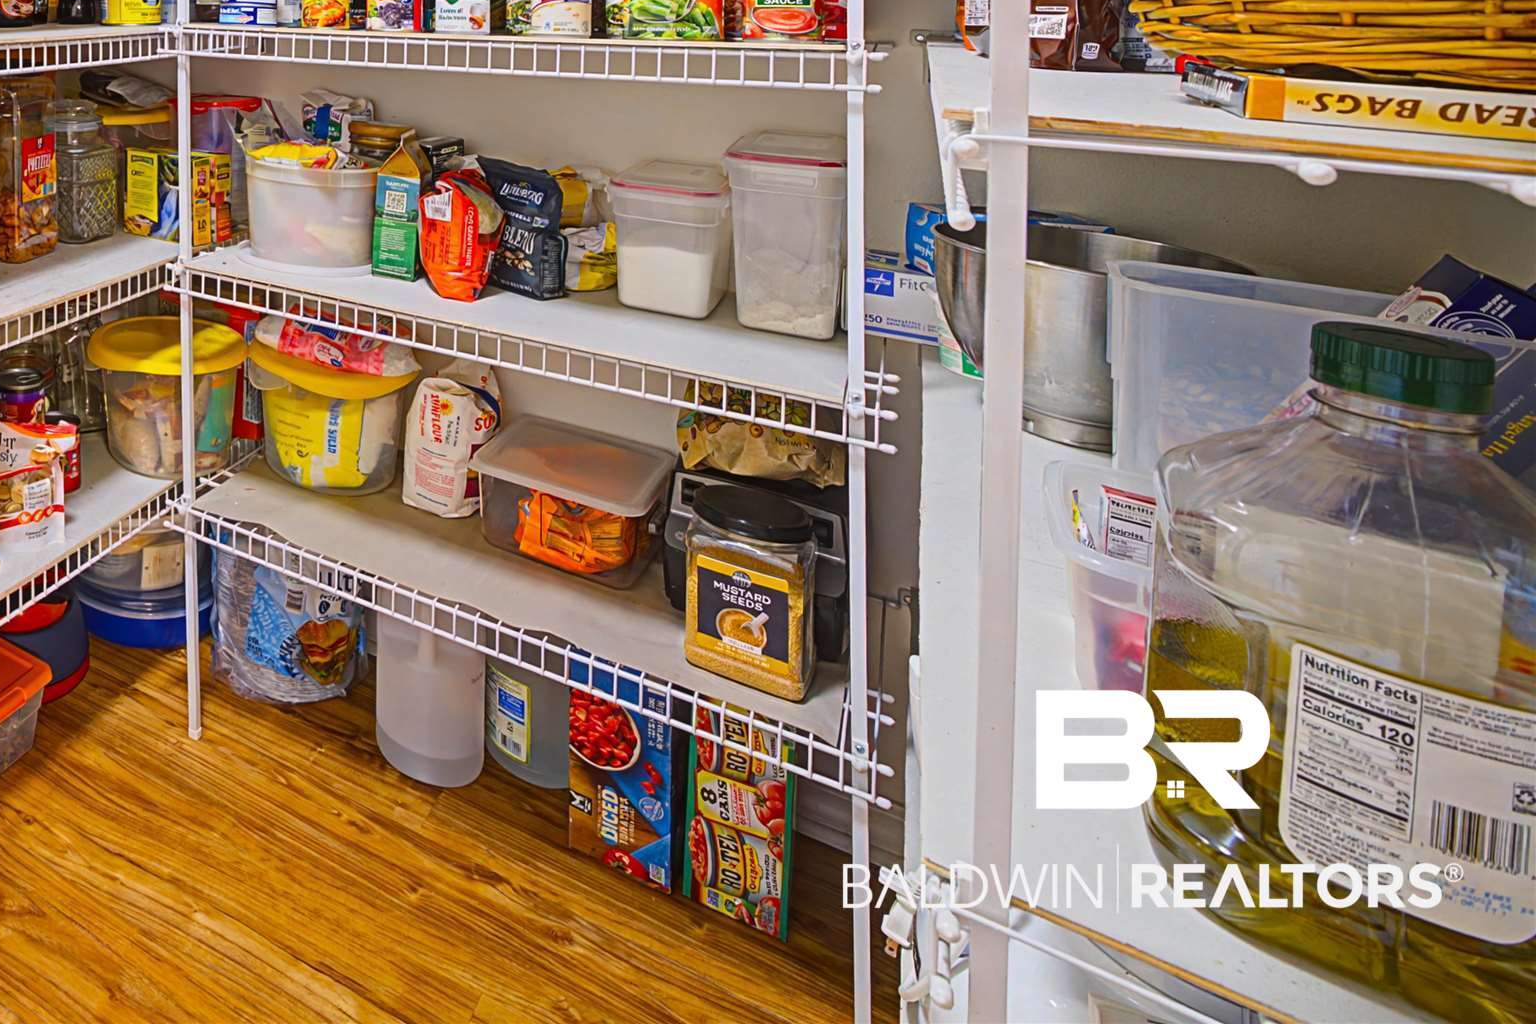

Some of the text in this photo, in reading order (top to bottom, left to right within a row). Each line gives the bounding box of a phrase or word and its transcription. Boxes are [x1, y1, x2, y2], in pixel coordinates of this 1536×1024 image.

[502, 224, 536, 254] BLEND
[713, 579, 772, 605] MUSTARD
[721, 592, 764, 612] SEEDS
[1303, 653, 1418, 705] Nutrition Facts
[1301, 698, 1415, 748] Calories 120
[700, 787, 717, 804] 8
[602, 788, 620, 844] DICED
